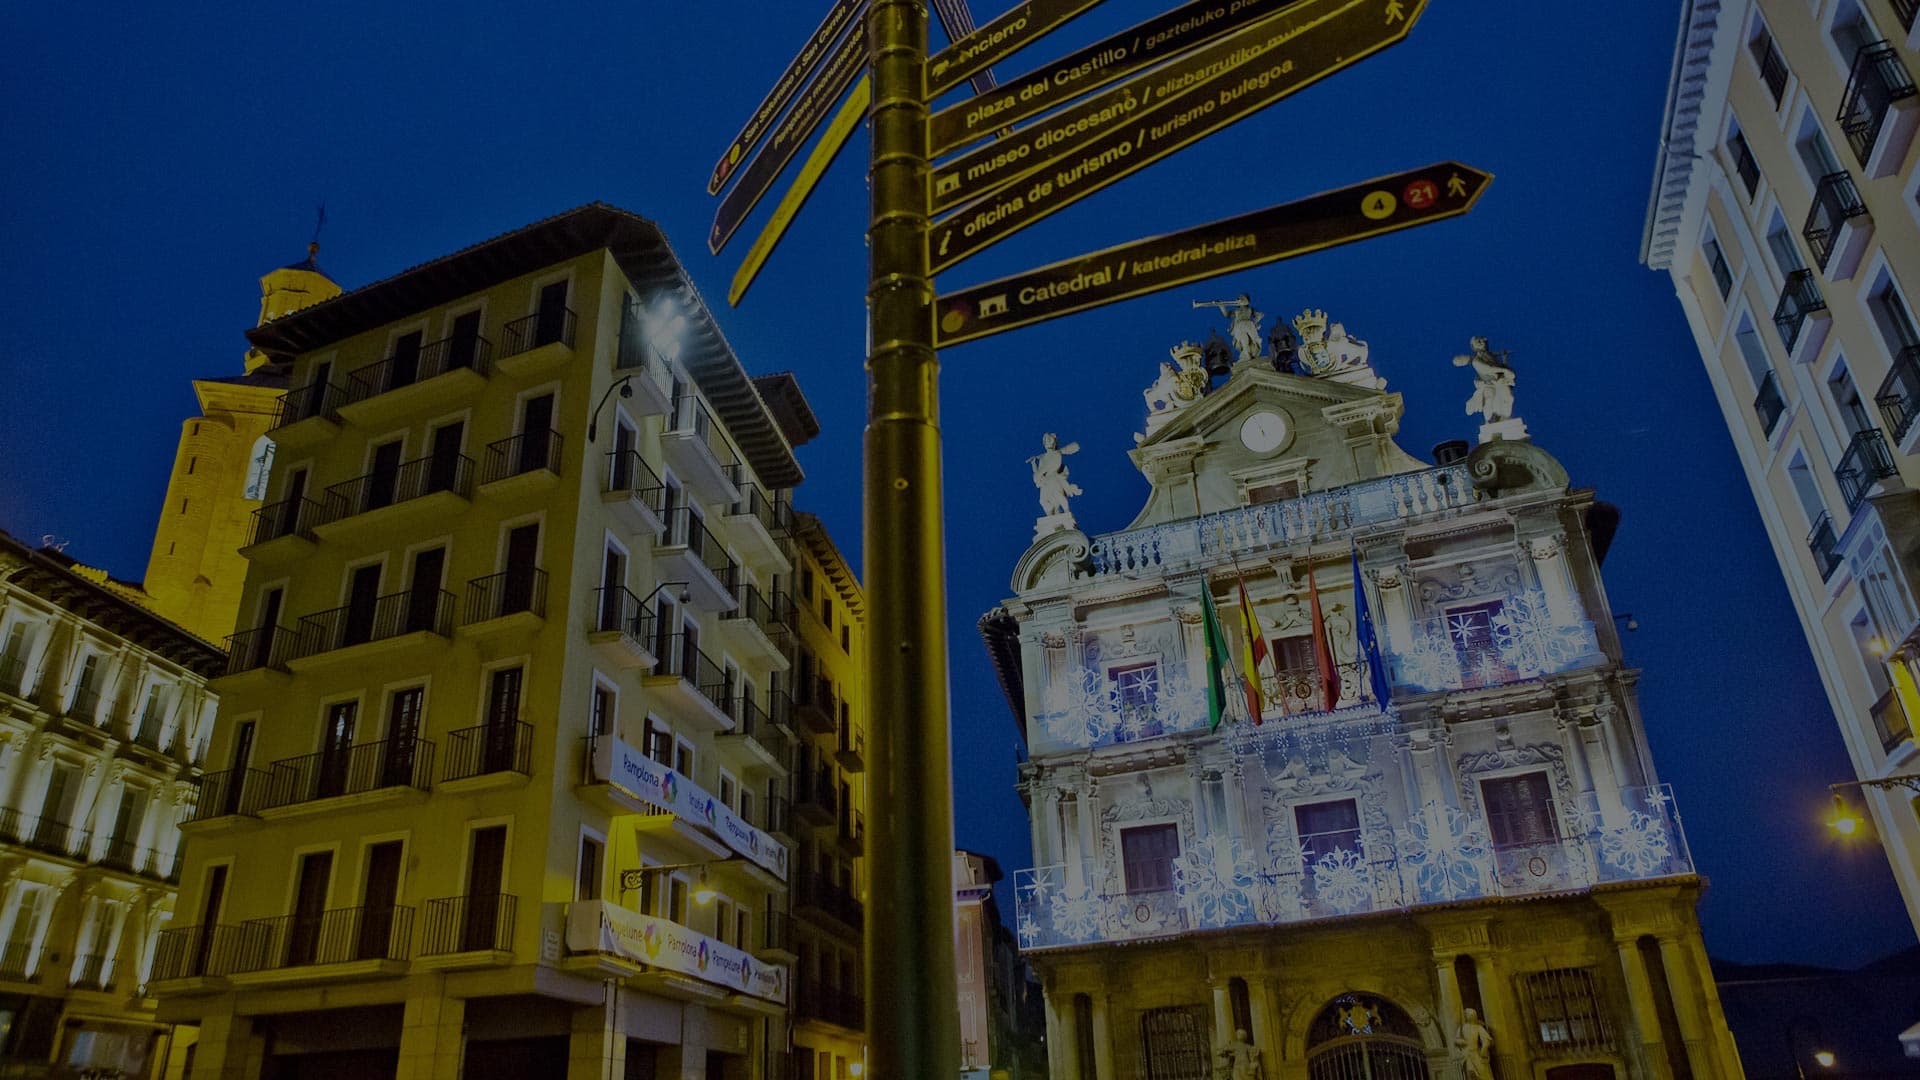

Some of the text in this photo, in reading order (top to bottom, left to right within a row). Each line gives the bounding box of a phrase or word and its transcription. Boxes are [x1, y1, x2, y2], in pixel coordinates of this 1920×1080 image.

[966, 94, 1016, 128] plaza
[1020, 77, 1049, 101] del
[1054, 44, 1127, 86] Castillo
[1145, 8, 1225, 50] gazteluko
[968, 144, 1030, 181] museo
[1034, 96, 1137, 150] diocesano
[1156, 44, 1262, 98] elizbarrutiko
[963, 196, 1024, 238] oficina
[1028, 181, 1053, 203] de
[1056, 141, 1132, 188] turismo
[1150, 100, 1216, 141] turismo
[1220, 58, 1294, 106] bulegoa
[1018, 265, 1112, 305] Catedral
[1131, 231, 1257, 277] katedral-eliza
[1409, 184, 1434, 204] 21
[623, 753, 659, 788] Pamplona
